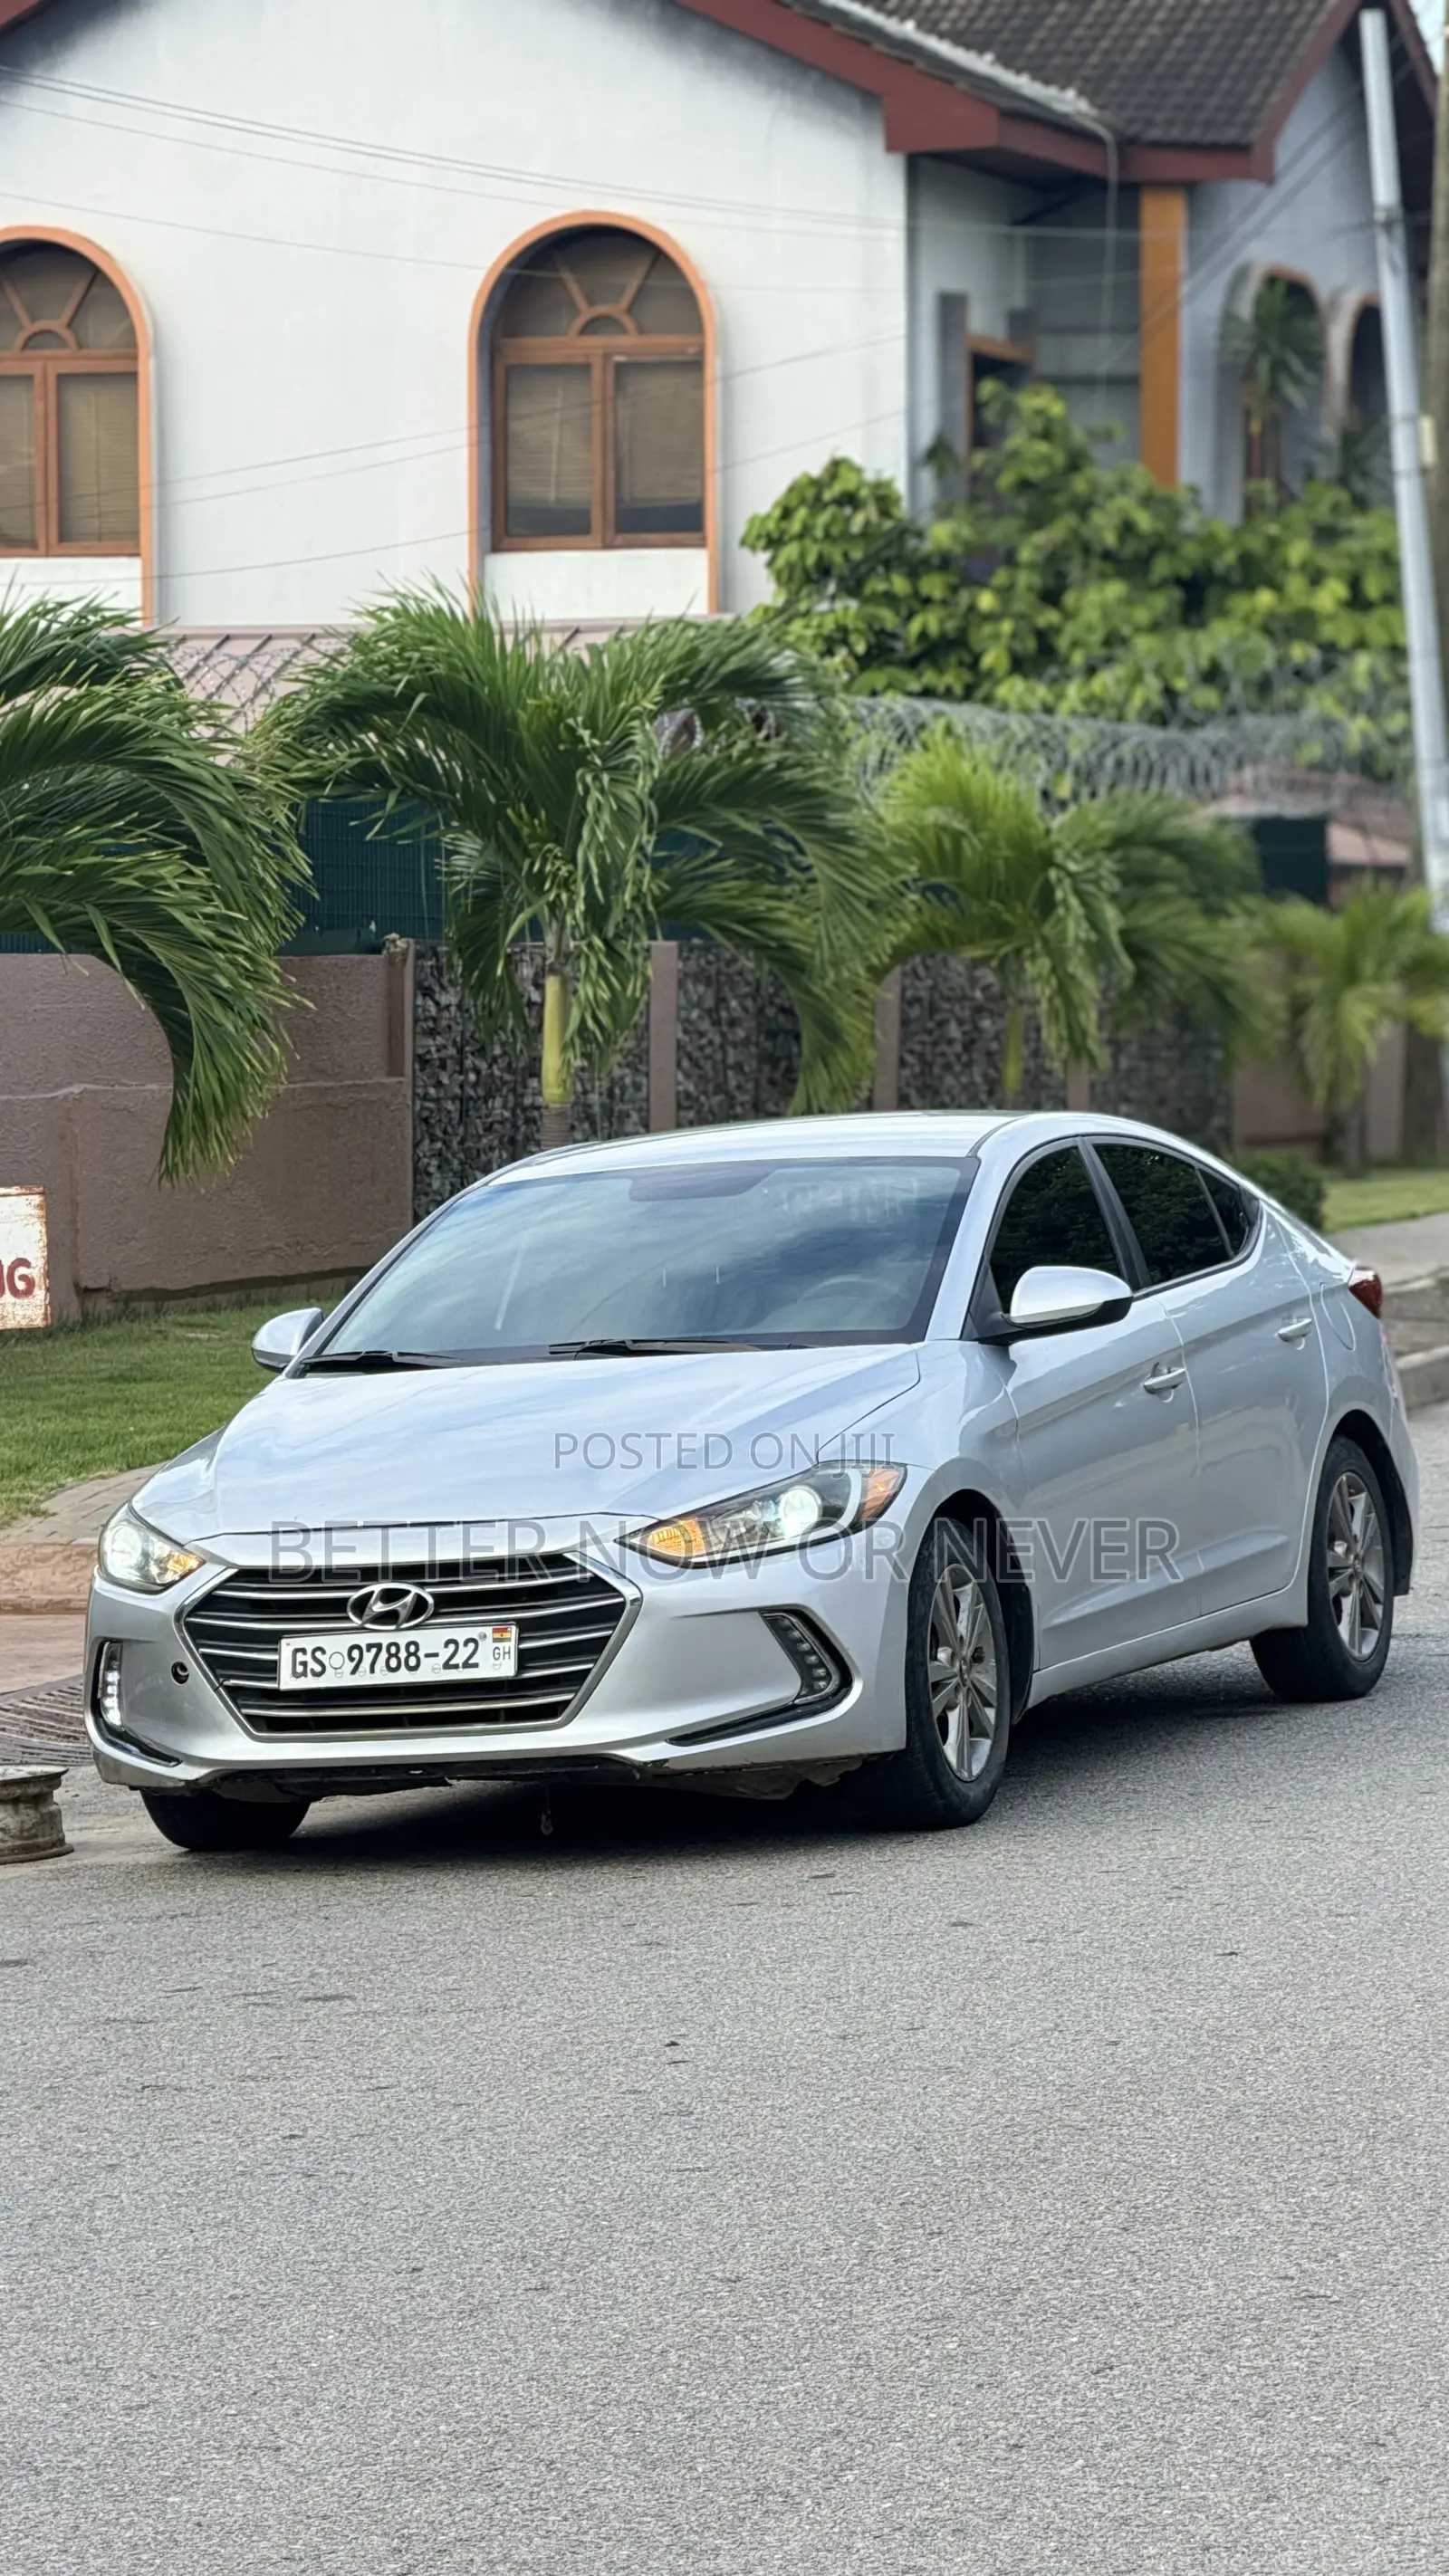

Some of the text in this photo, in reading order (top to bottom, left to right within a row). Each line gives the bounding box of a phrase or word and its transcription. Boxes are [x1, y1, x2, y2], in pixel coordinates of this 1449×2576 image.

[0, 1258, 35, 1299] G
[291, 1637, 480, 1679] GS 9788-22
[492, 1645, 512, 1661] GH
